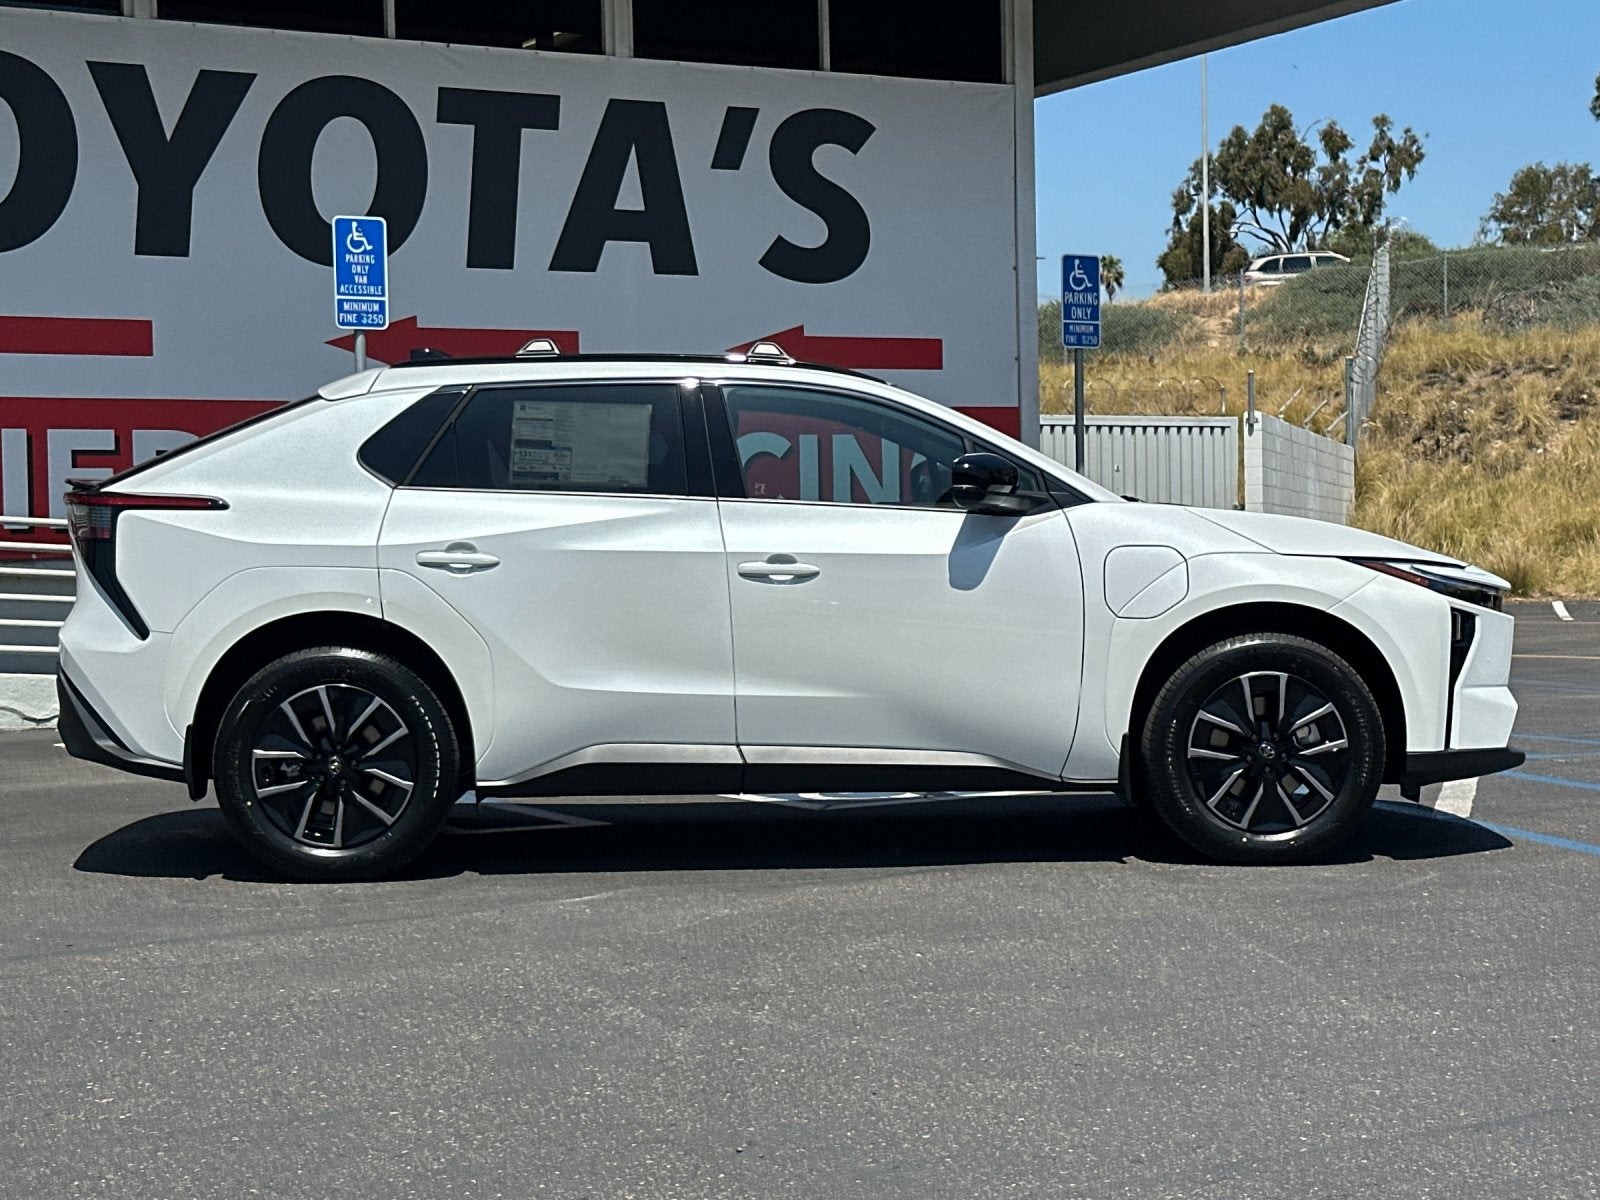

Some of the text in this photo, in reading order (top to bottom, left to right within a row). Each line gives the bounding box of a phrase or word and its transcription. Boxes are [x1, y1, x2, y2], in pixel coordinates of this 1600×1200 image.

[345, 254, 375, 264] PARKING
[352, 265, 369, 274] ONLY
[354, 275, 368, 284] VAN
[340, 284, 382, 295] ACCESSIBLE
[1064, 292, 1098, 305] PARKING
[343, 302, 379, 312] MINIMUM
[339, 313, 358, 323] FINE
[1071, 307, 1092, 320] ONLY
[1069, 324, 1094, 333] MINIMUM
[1065, 335, 1098, 345] FINE $250
